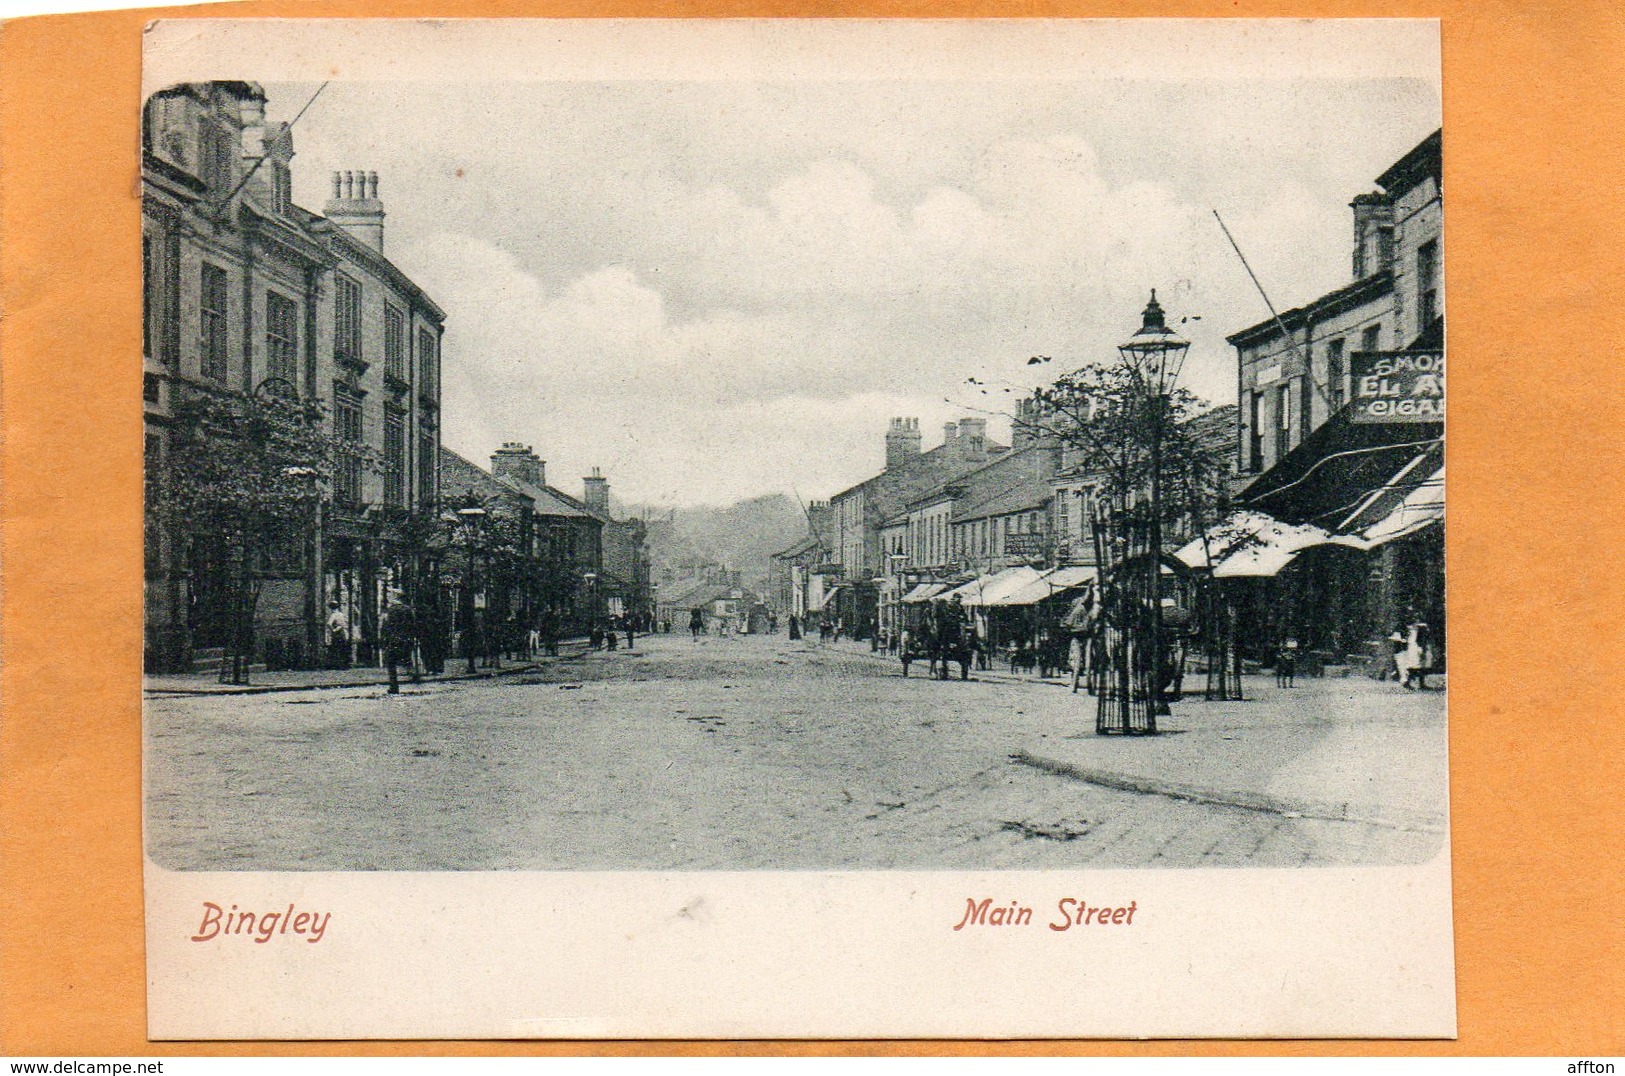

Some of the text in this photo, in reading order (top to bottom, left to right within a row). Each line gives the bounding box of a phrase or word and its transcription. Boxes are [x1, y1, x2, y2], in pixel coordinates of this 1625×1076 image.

[1359, 375, 1401, 398] EL
[191, 902, 331, 943] Bingley
[953, 898, 1137, 931] Main Street
